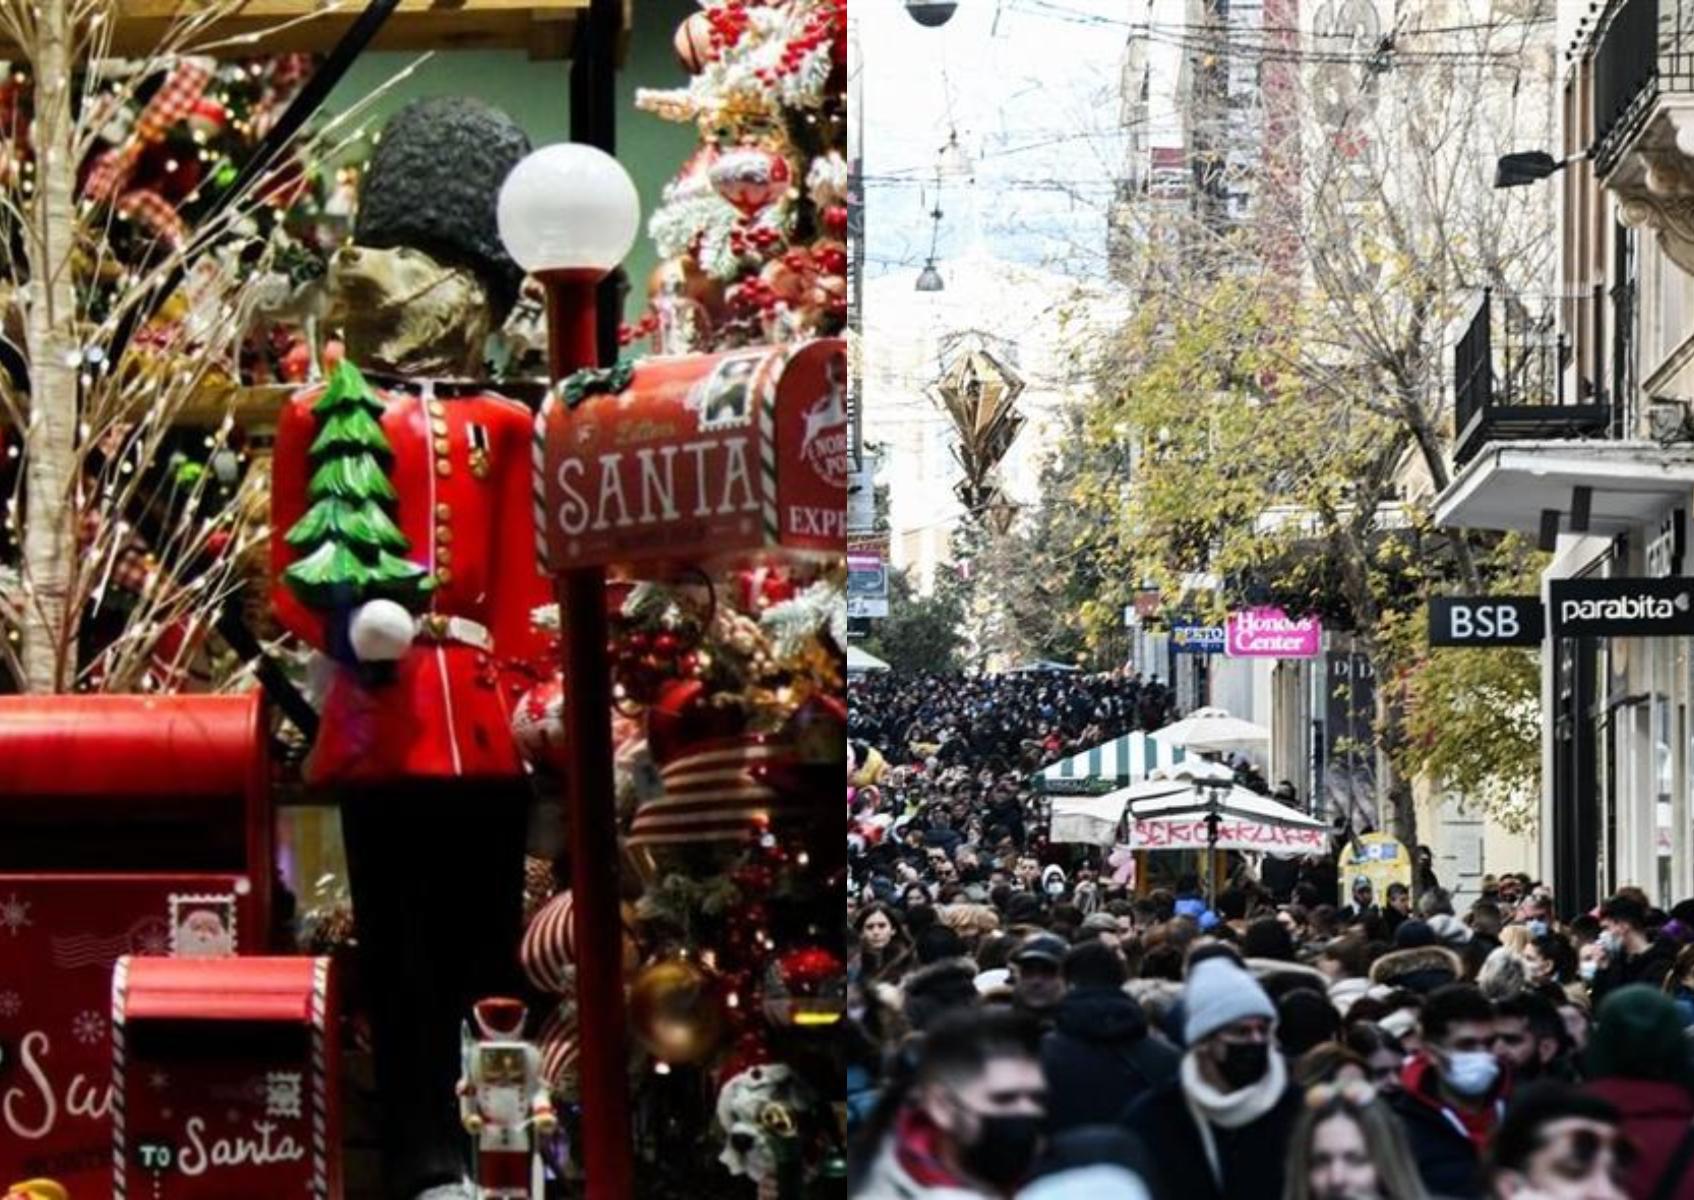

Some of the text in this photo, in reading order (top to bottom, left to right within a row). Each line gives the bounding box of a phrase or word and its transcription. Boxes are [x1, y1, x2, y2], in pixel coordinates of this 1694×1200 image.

[557, 437, 759, 535] SANTA
[1451, 605, 1520, 638] BSB
[1561, 595, 1674, 624] parabita
[1235, 632, 1304, 651] Center
[138, 1146, 170, 1166] TO
[178, 1117, 304, 1175] Santa
